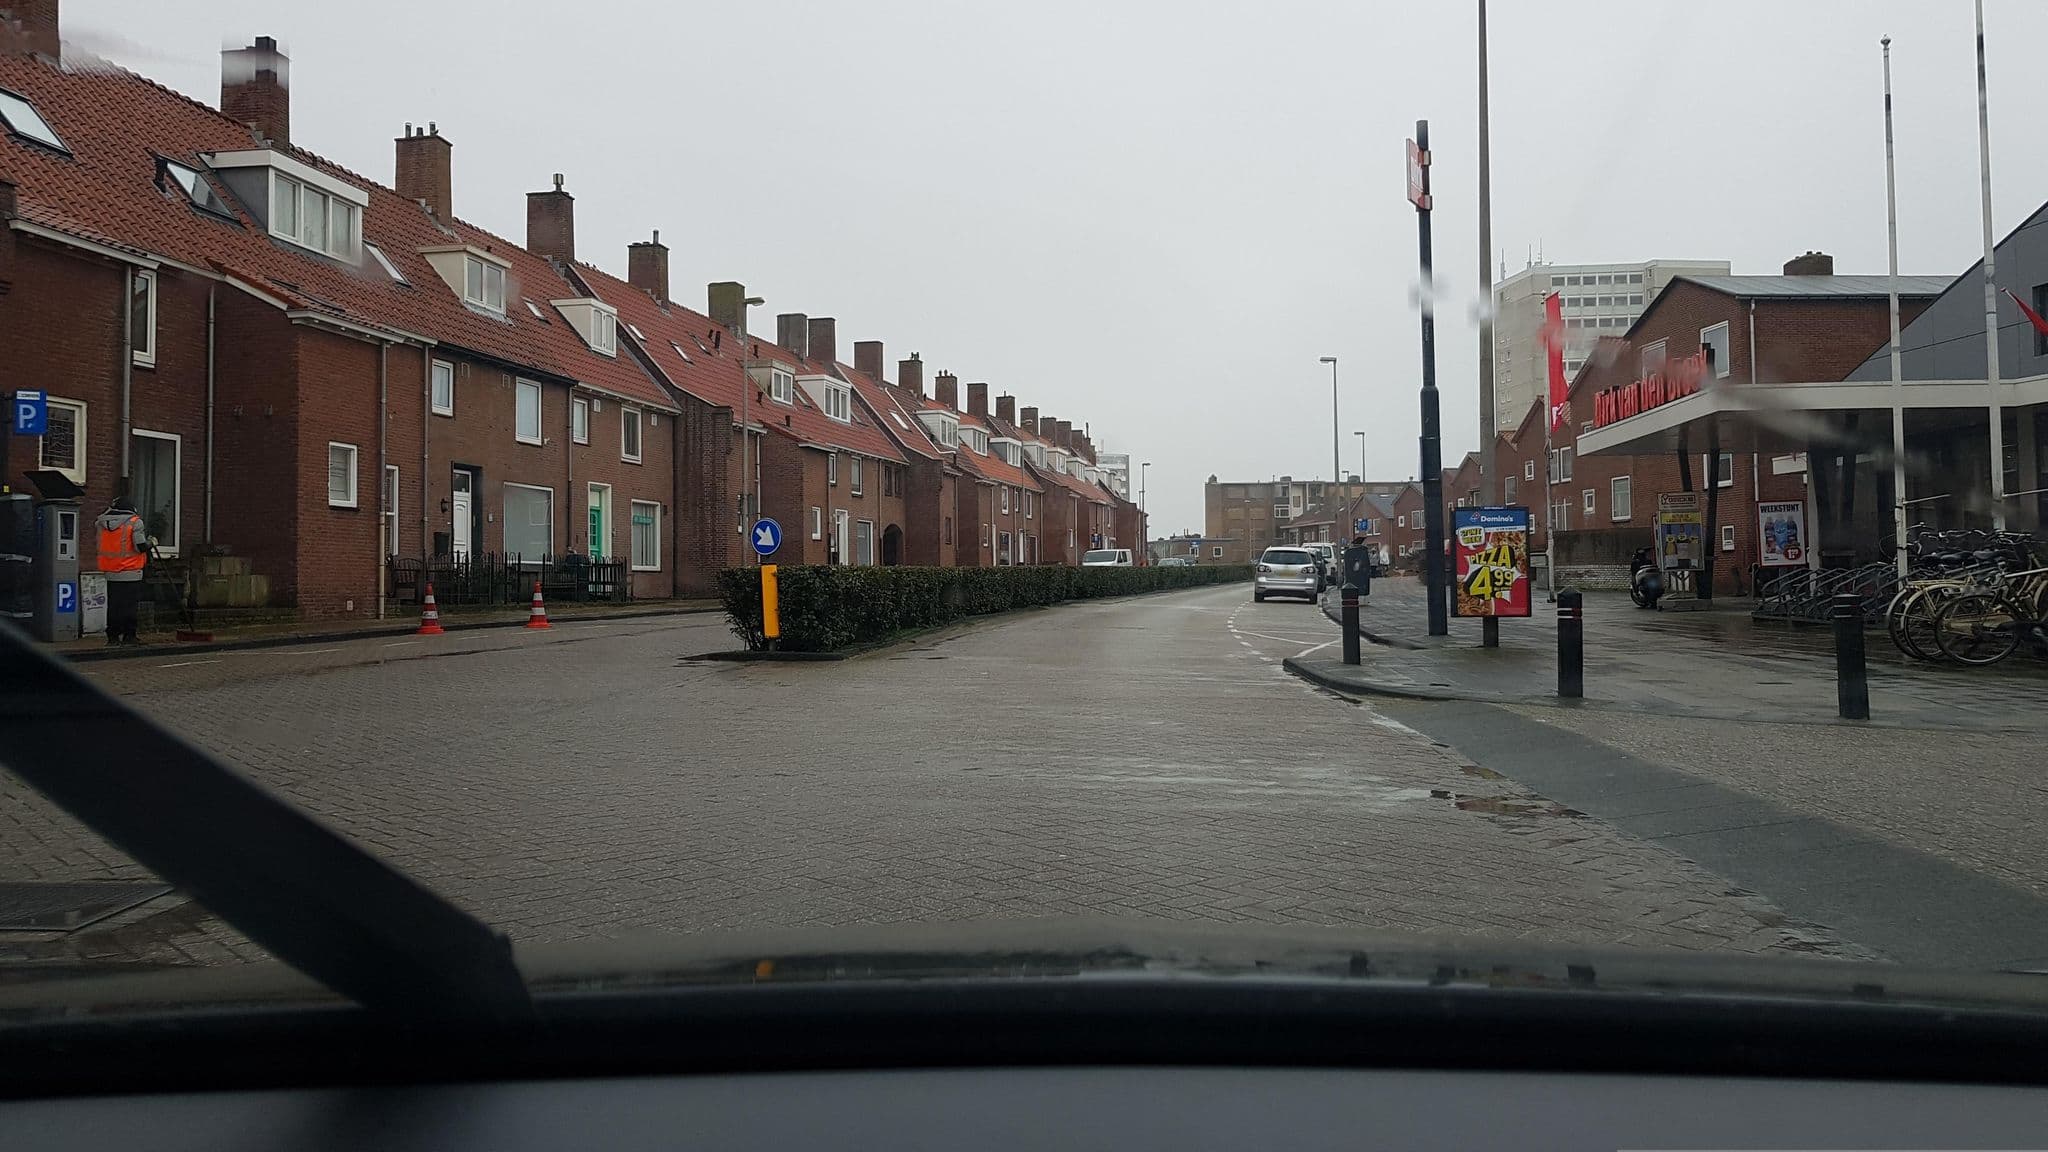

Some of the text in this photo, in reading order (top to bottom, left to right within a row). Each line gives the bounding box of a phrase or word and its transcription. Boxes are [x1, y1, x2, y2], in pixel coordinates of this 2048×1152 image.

[1593, 385, 1616, 428] Dirk
[1617, 380, 1640, 420] van
[19, 404, 37, 429] P
[1760, 504, 1799, 513] WEEKSTUNT
[1470, 545, 1512, 569] PIZZA
[58, 583, 72, 607] P
